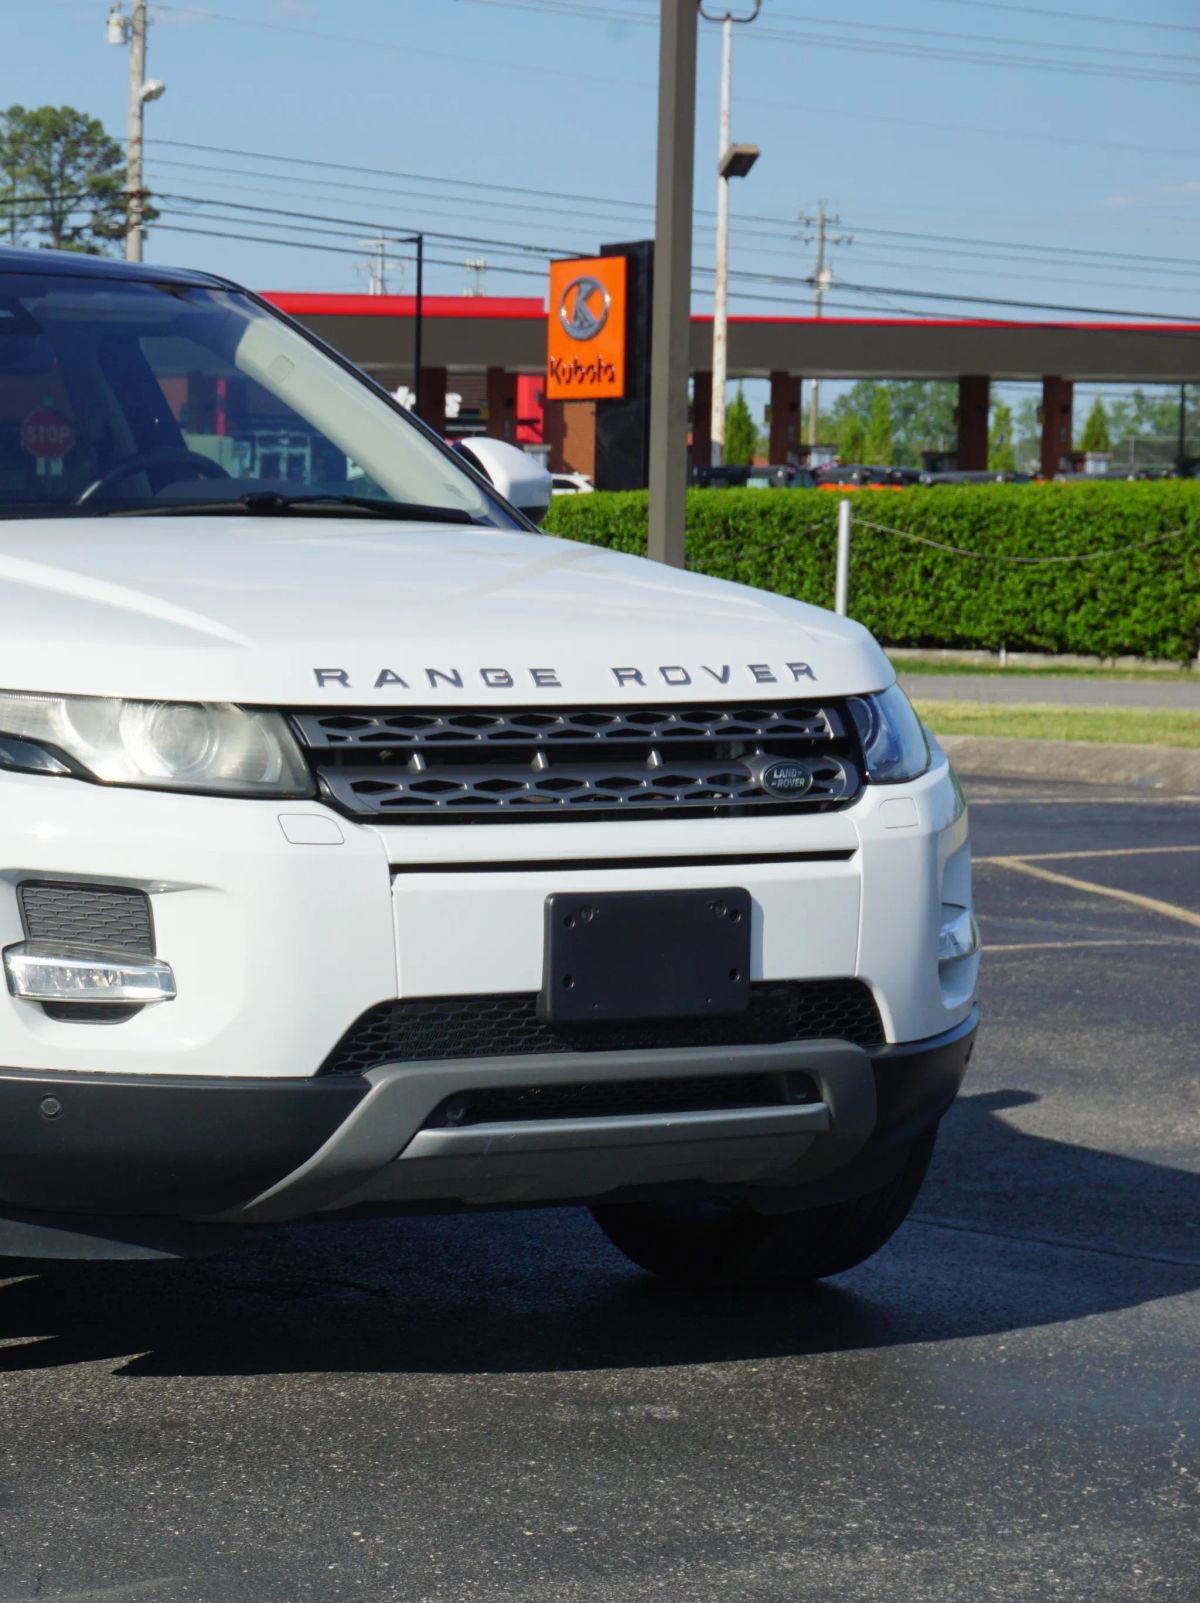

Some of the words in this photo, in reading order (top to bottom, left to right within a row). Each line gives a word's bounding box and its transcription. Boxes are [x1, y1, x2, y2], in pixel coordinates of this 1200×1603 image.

[549, 354, 616, 385] Kubota
[27, 424, 71, 444] STOP
[313, 667, 563, 689] RANGE
[610, 661, 818, 688] ROVER
[773, 767, 797, 779] LAND
[776, 777, 806, 789] ROVER
